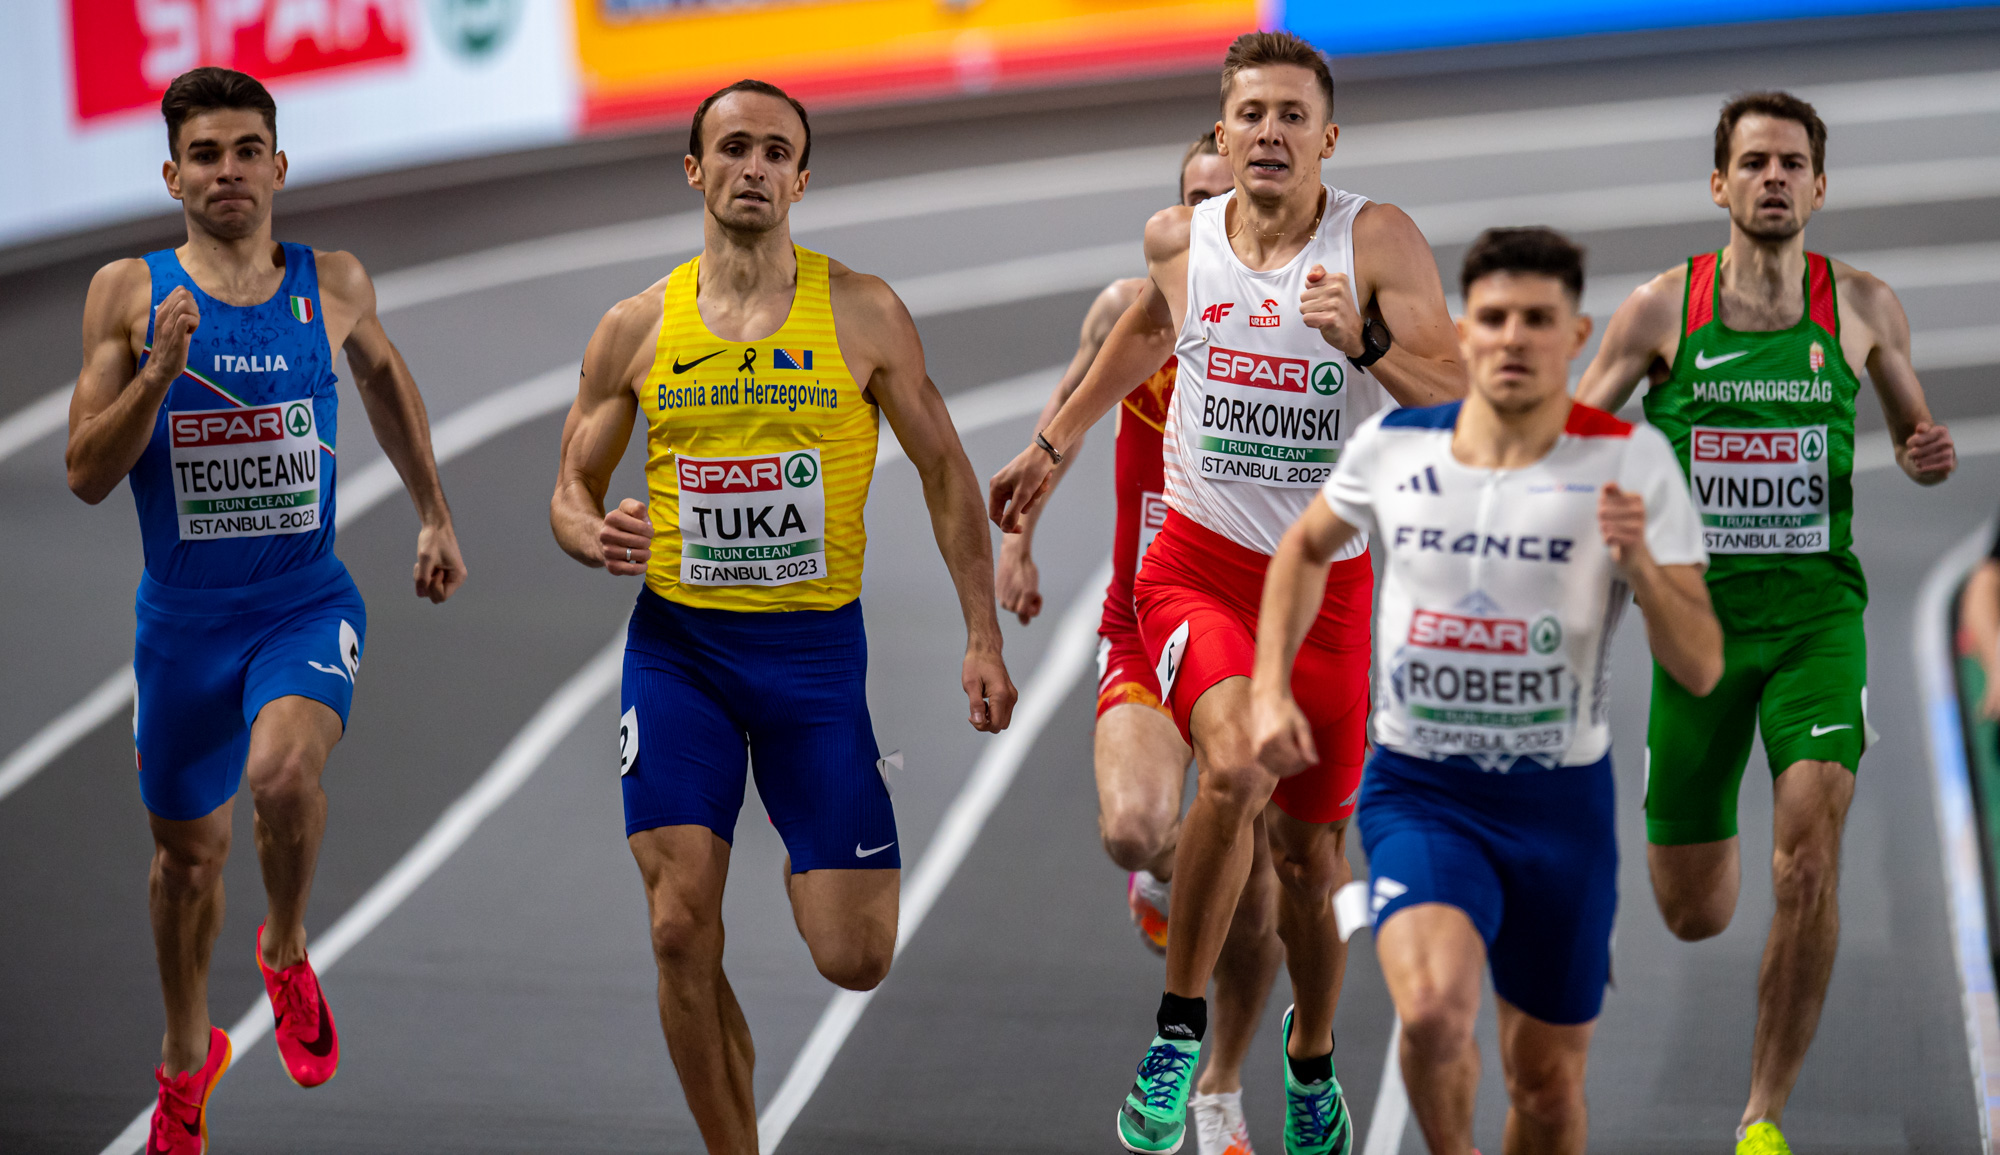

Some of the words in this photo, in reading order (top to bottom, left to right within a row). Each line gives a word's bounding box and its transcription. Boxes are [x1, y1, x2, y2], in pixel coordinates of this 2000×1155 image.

[214, 354, 288, 373] ITALIA
[1209, 351, 1307, 389] SPAR
[657, 379, 706, 411] Bosnia
[711, 377, 739, 406] and
[743, 377, 838, 412] Herzegovina
[1692, 376, 1833, 403] MAGYARORSZÁG
[175, 412, 281, 443] SPAR
[1202, 394, 1341, 441] BORKOWSKI
[1228, 440, 1258, 455] RUN
[1697, 434, 1797, 460] SPAR
[176, 449, 316, 493] TECUCEANU
[680, 462, 779, 490] SPAR
[1201, 456, 1283, 482] ISTANBUL
[1695, 475, 1824, 508] VINDICS
[216, 499, 245, 512] RUN
[189, 514, 276, 535] ISTANBUL
[280, 509, 315, 529] 2023
[692, 503, 807, 540] TUKA
[1727, 516, 1755, 527] RUN
[714, 547, 743, 560] RUN
[1395, 527, 1575, 564] FRANCE
[1703, 532, 1781, 549] ISTANBUL
[1785, 532, 1822, 548] 2023
[690, 563, 773, 581] ISTANBUL
[776, 558, 818, 580] 2023
[1411, 613, 1527, 650] SPAR
[1408, 661, 1565, 705] ROBERT
